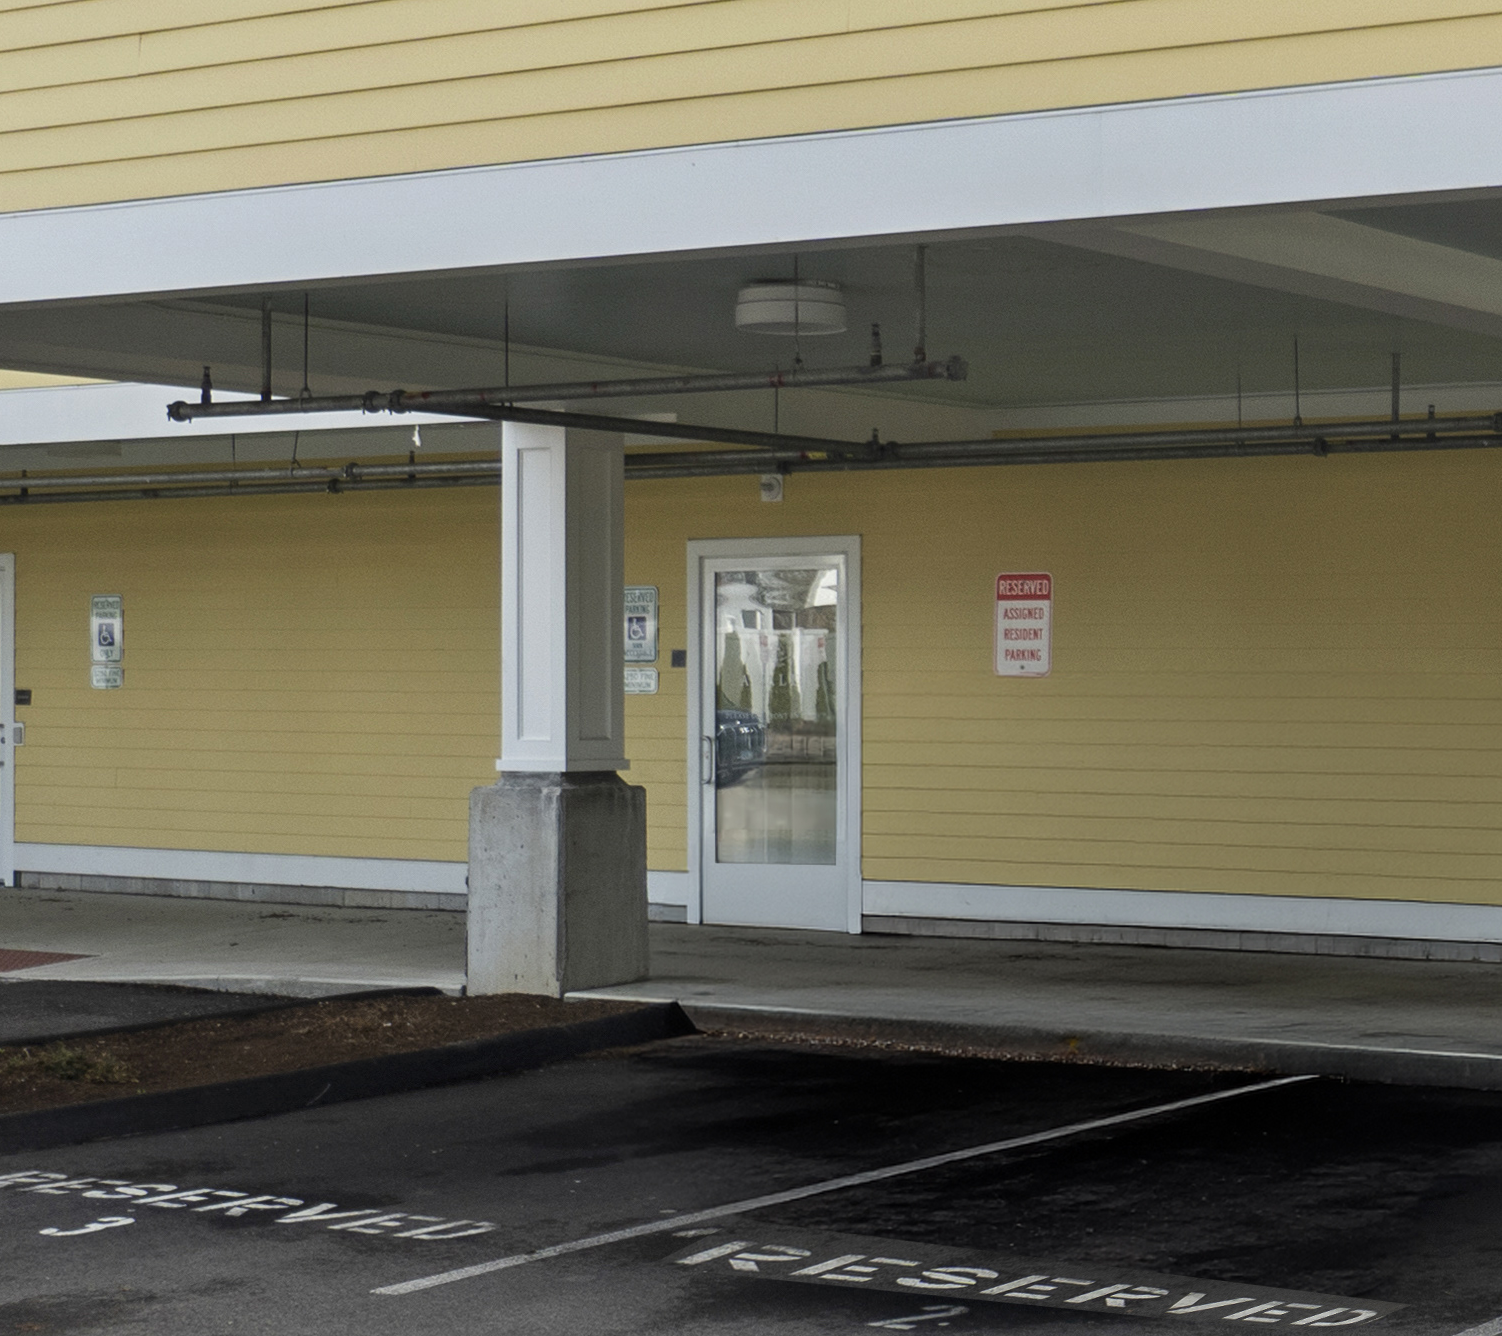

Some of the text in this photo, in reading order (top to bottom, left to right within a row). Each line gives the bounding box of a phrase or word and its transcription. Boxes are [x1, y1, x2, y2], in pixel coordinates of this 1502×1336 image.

[999, 580, 1049, 595] RESERVED
[1003, 608, 1044, 620] ASSIGNED
[1004, 628, 1043, 641] RESIDENT
[1005, 649, 1042, 661] PARKING
[38, 1216, 136, 1237] 3
[675, 1240, 1379, 1329] RESERVED
[866, 1305, 969, 1331] 2
